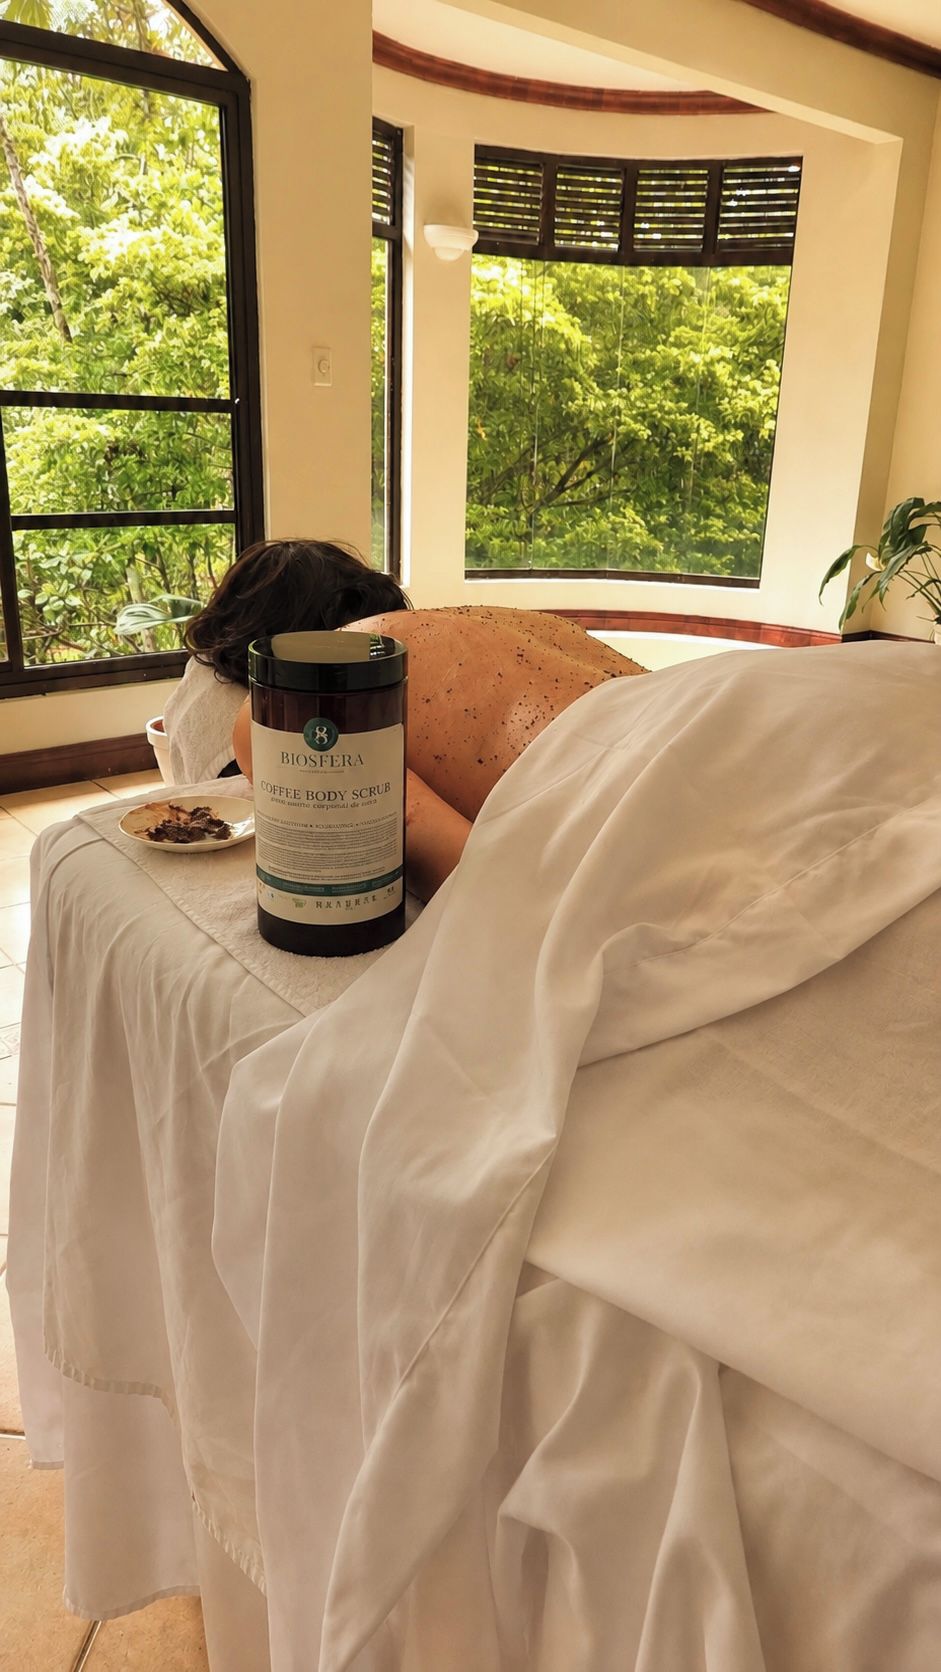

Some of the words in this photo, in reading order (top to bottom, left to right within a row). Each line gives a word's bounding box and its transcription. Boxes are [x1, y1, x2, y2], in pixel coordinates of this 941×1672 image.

[281, 752, 364, 768] BIOSFERA
[260, 780, 301, 800] COFFEE
[306, 790, 347, 802] BODY
[352, 782, 391, 800] SCRUB
